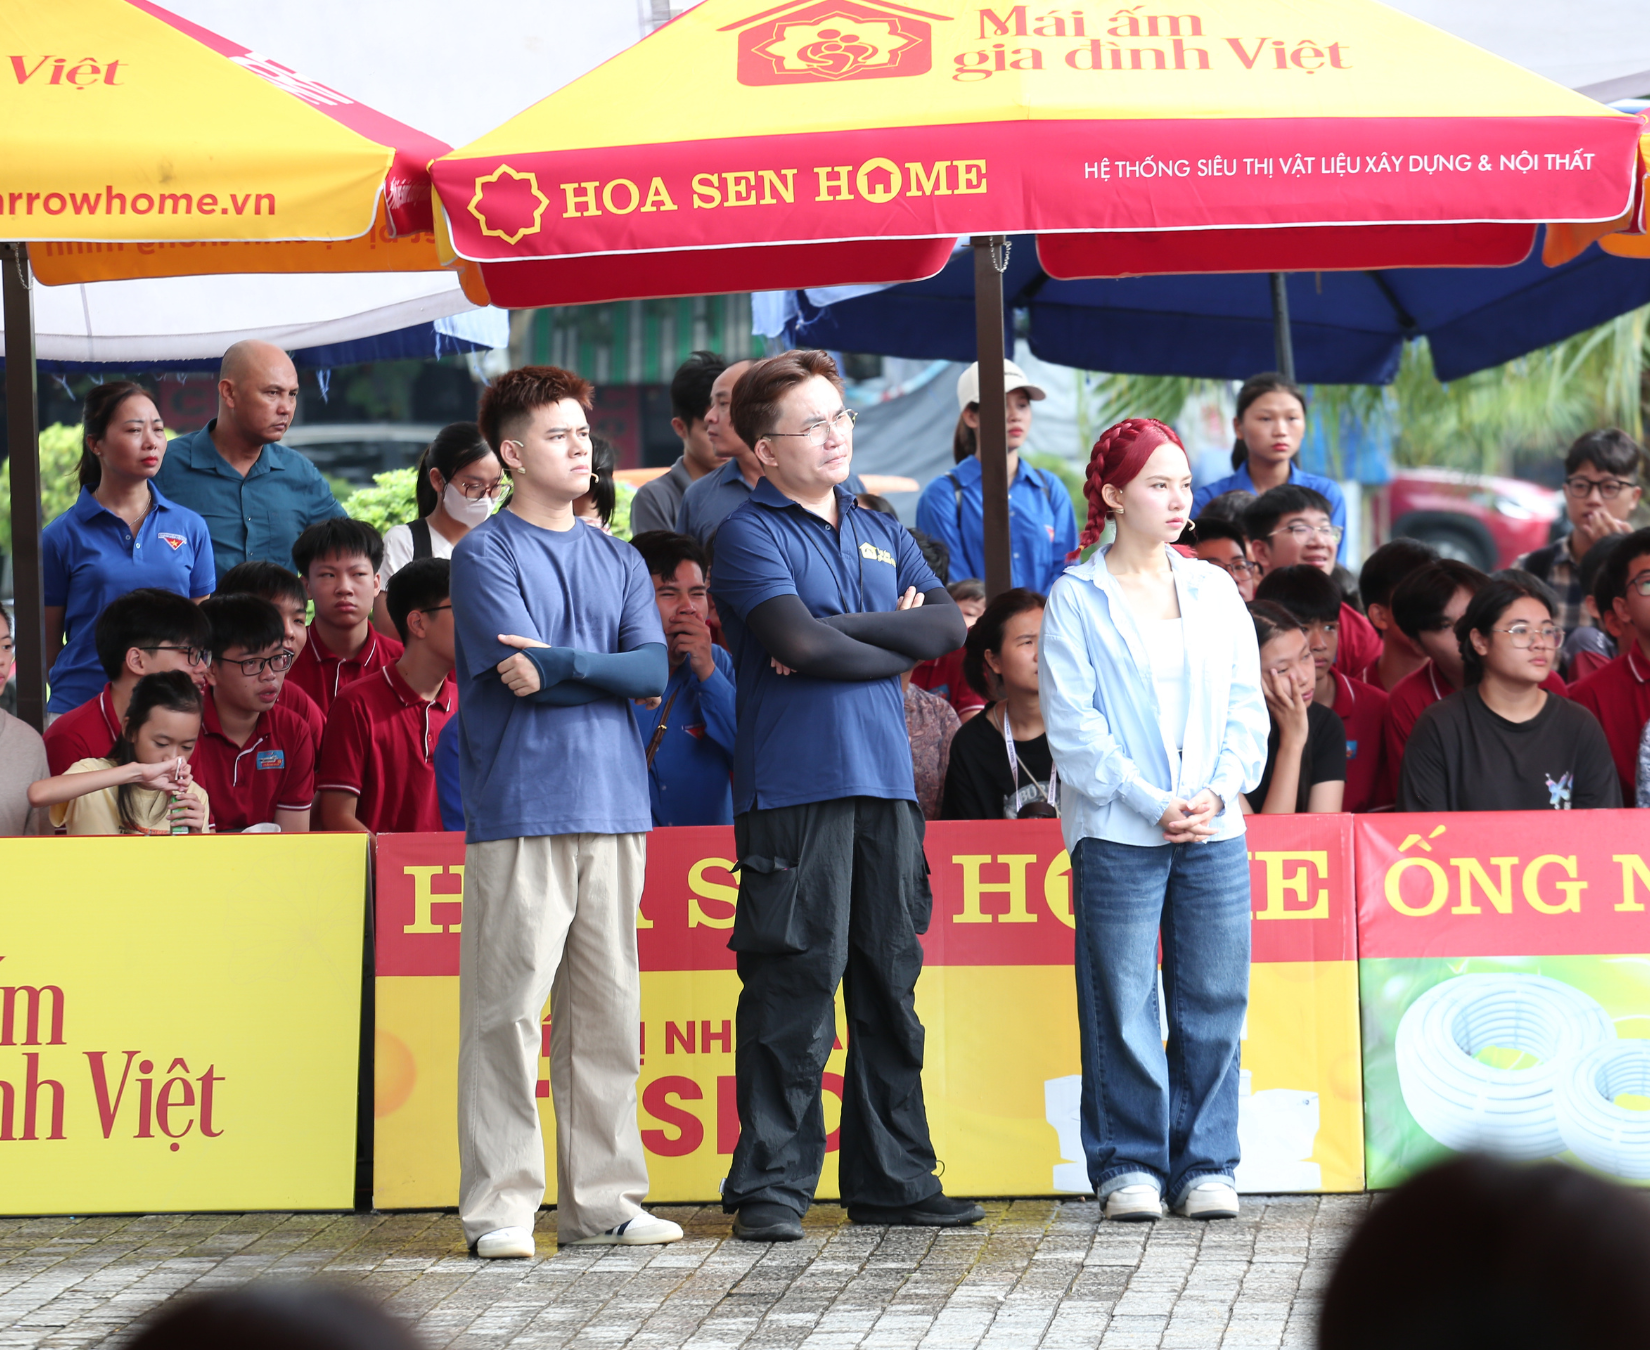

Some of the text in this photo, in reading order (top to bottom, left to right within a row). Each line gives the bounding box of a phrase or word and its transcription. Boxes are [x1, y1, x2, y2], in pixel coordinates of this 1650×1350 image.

[978, 6, 1205, 39] Mái ấm
[7, 55, 129, 90] Việt
[952, 37, 1353, 82] gia đình Việt
[1084, 148, 1595, 181] HỆ THỐNG SIÊU THỊ VẬT LIỆU XÂY DỰNG & NỘI THẤT
[0, 185, 276, 216] rrowhome.vn
[560, 157, 988, 218] HOA SEN HOME
[1384, 824, 1588, 917] ỐNG
[82, 1050, 226, 1152] Việt
